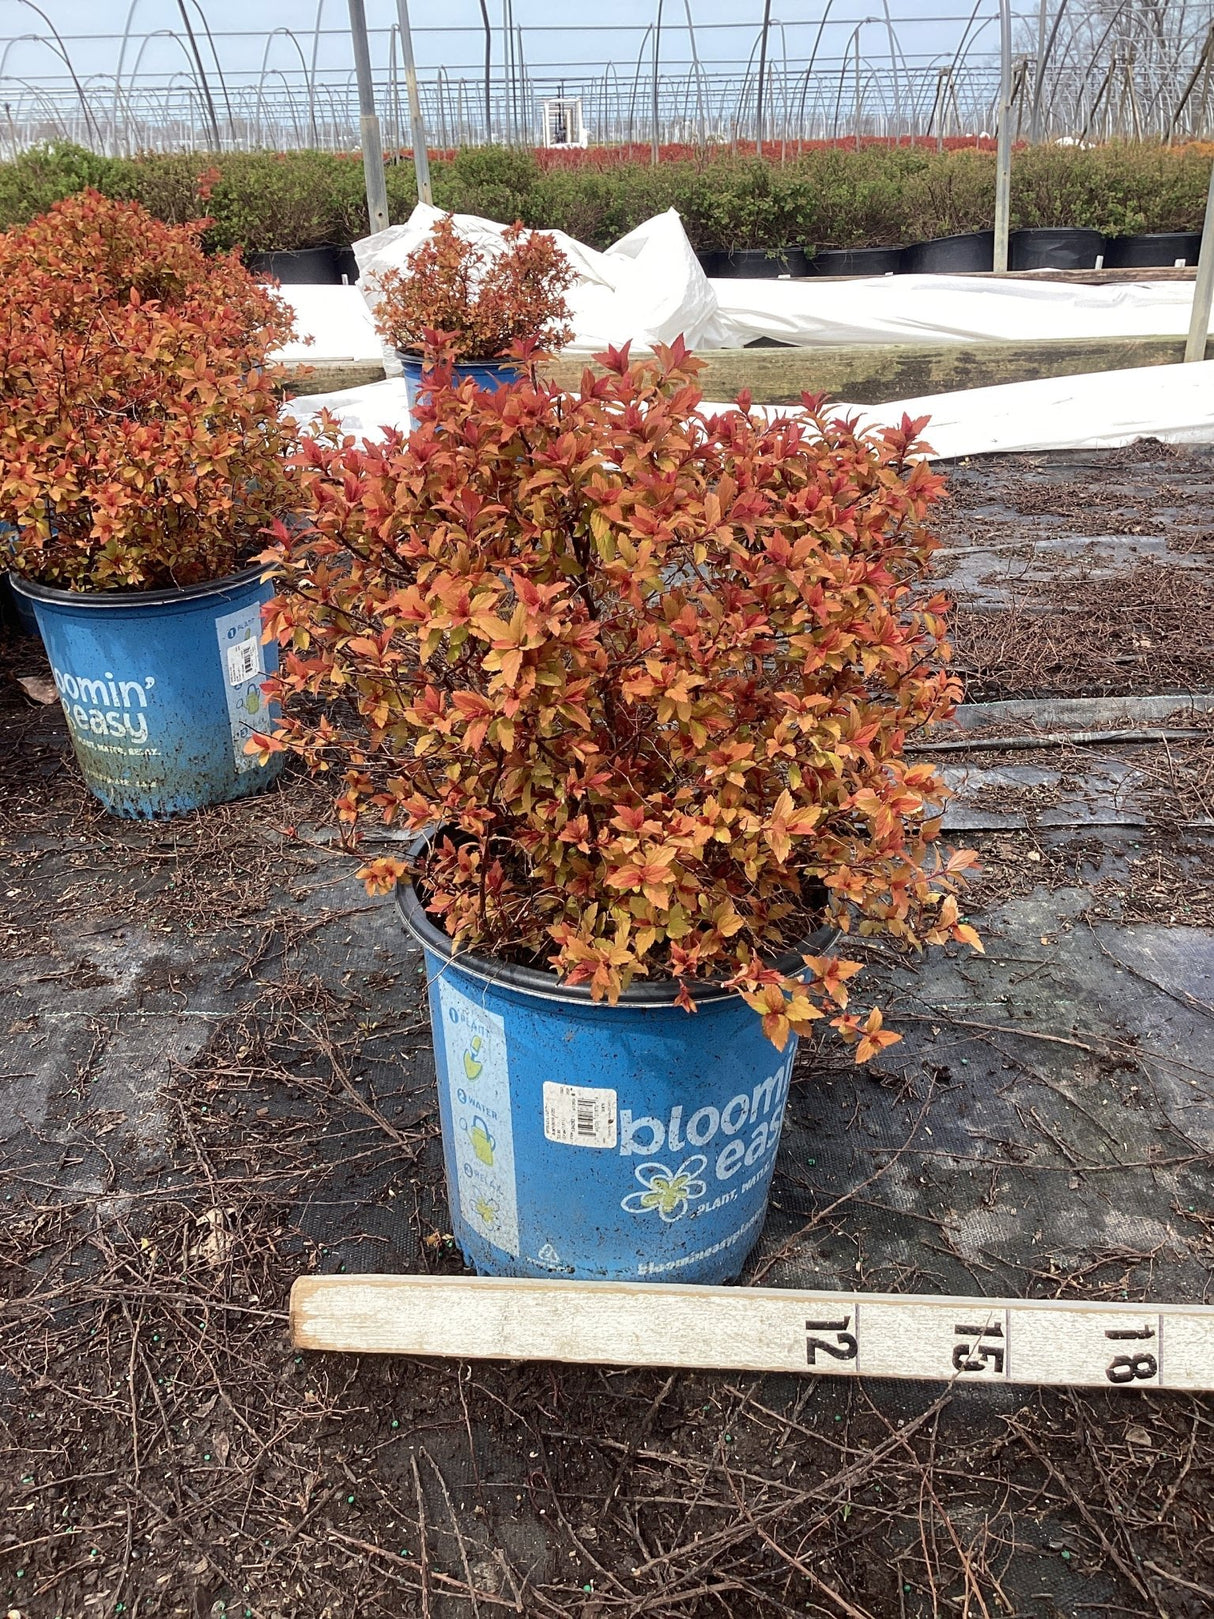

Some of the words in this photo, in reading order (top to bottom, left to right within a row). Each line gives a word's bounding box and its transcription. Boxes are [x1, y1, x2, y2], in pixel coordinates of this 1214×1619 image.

[73, 704, 149, 744] easy
[459, 1011, 490, 1038] PLANT
[468, 1096, 499, 1120] WATER
[805, 1315, 858, 1365] 12
[952, 1321, 1004, 1373] 15
[1104, 1325, 1158, 1383] 18
